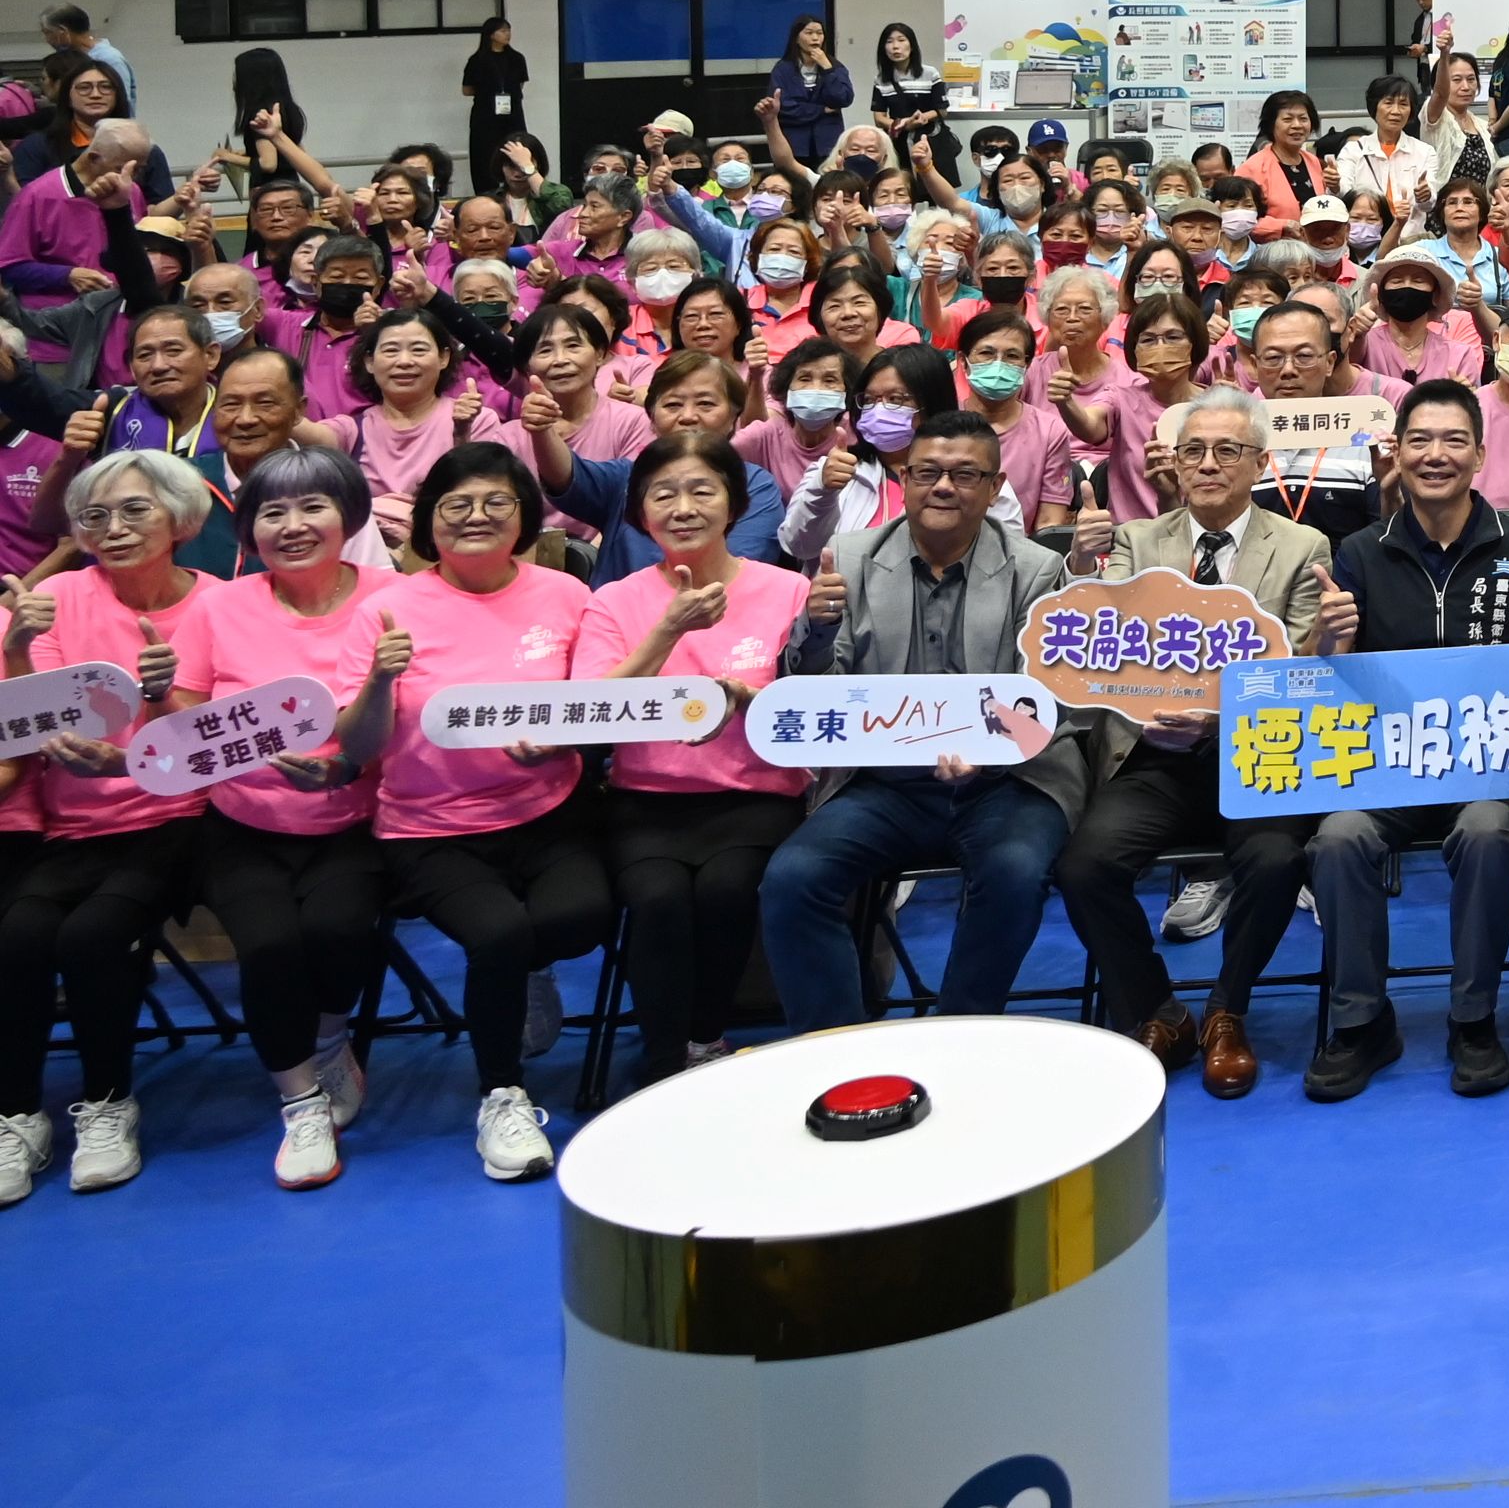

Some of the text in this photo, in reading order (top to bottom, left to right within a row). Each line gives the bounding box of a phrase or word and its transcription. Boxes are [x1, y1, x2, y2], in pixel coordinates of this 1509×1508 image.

[1272, 412, 1352, 432] 幸福同行
[1468, 577, 1487, 645] 局長 孫
[1042, 608, 1266, 671] 共融共好
[0, 705, 84, 747] 營業中
[192, 701, 261, 740] 世代
[446, 698, 664, 729] 樂齡步調 潮流人生
[770, 694, 949, 744] 臺東 WAY
[186, 726, 288, 778] 零距離
